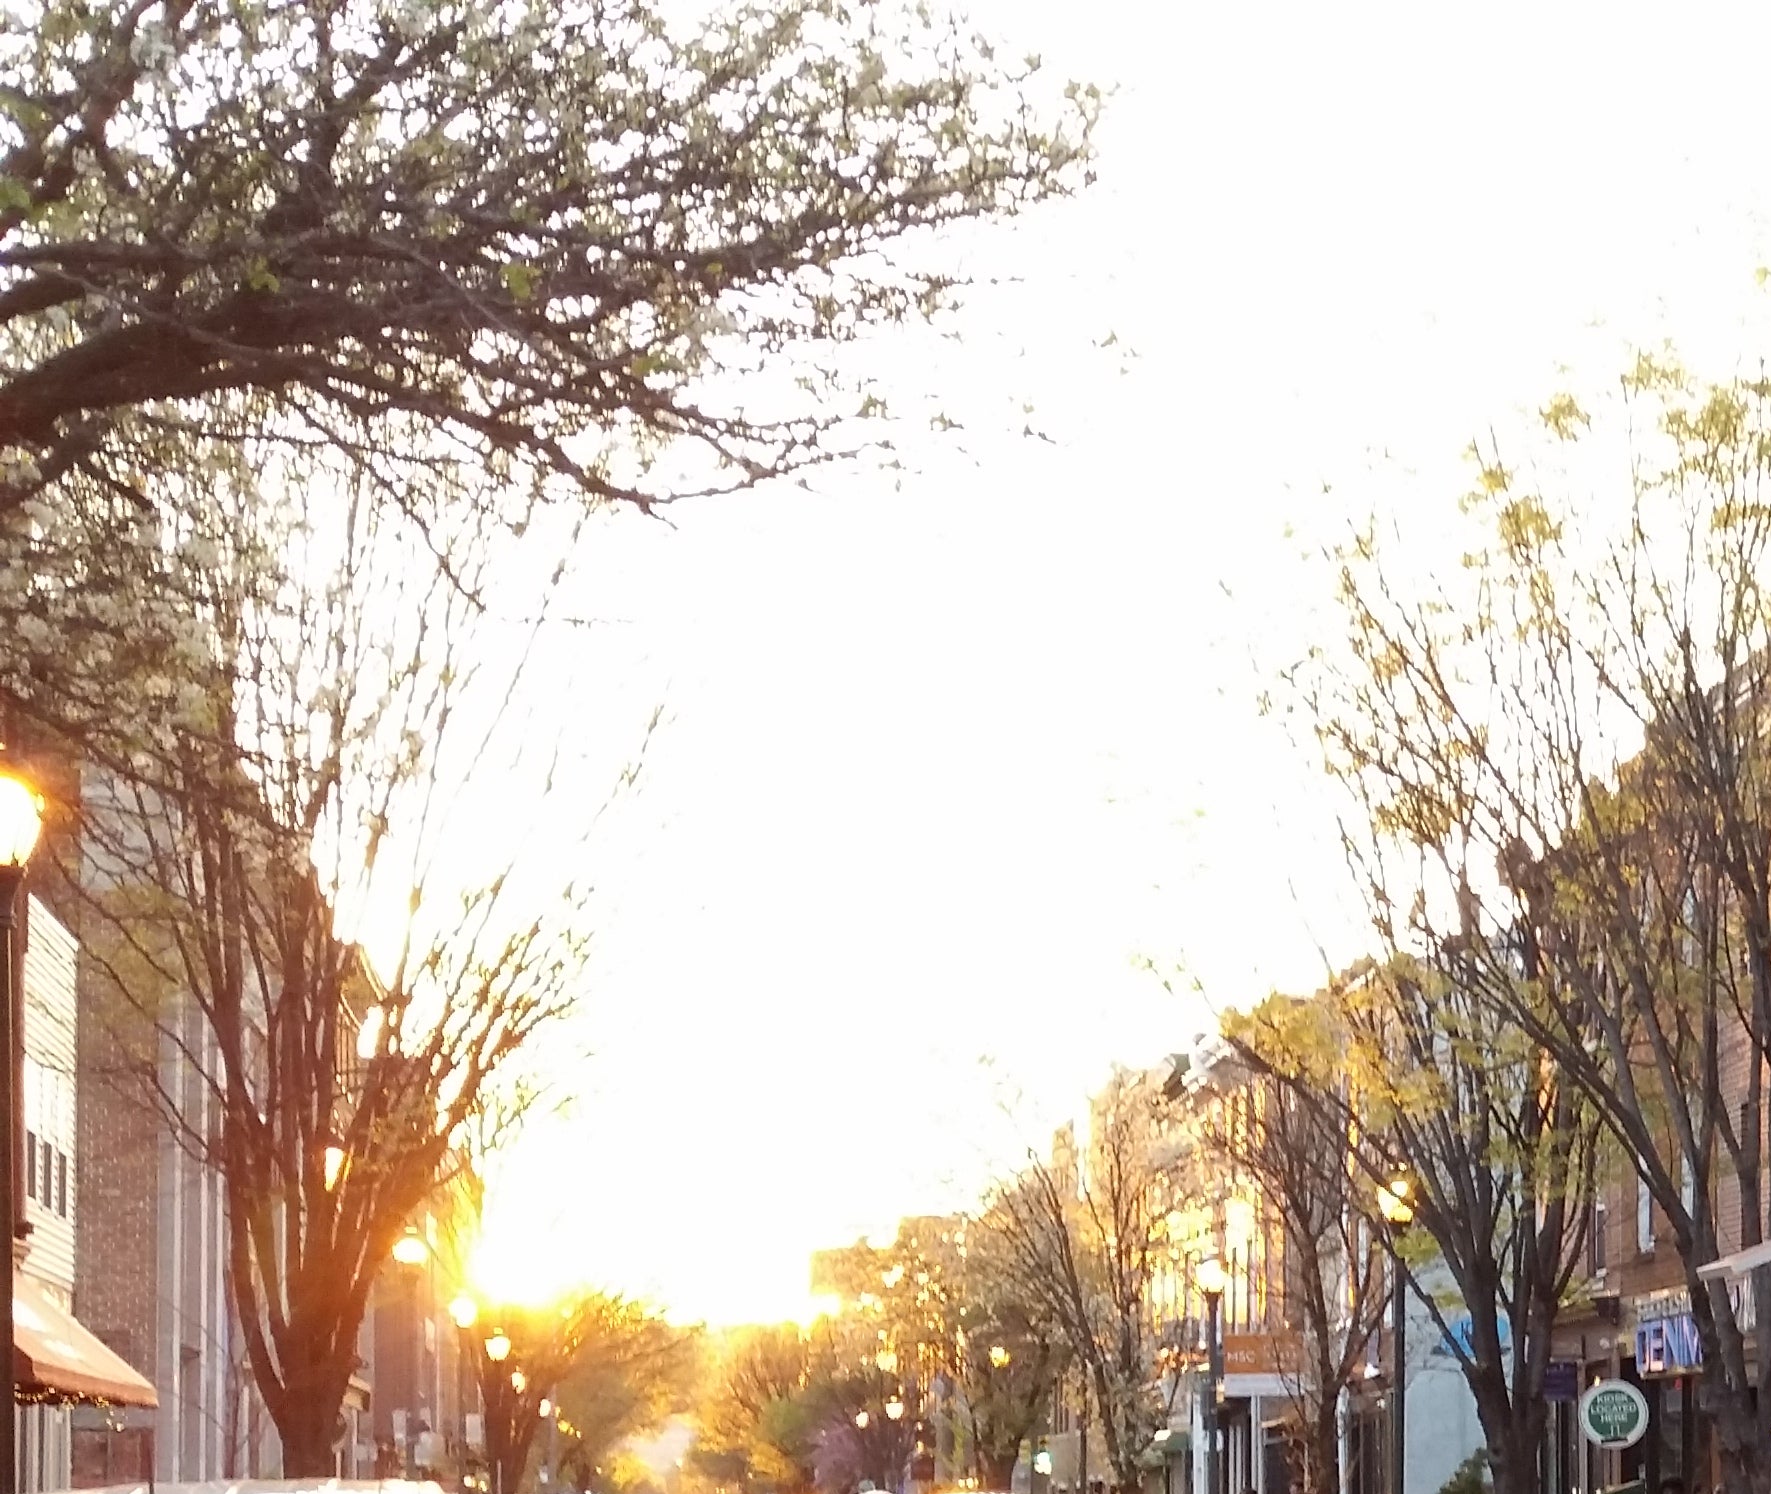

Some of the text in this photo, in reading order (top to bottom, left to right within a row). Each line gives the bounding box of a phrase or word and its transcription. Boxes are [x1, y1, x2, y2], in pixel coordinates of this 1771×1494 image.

[1596, 1393, 1629, 1404] KIOSK
[1590, 1402, 1637, 1415] LOCATED
[1600, 1414, 1628, 1424] HERE
